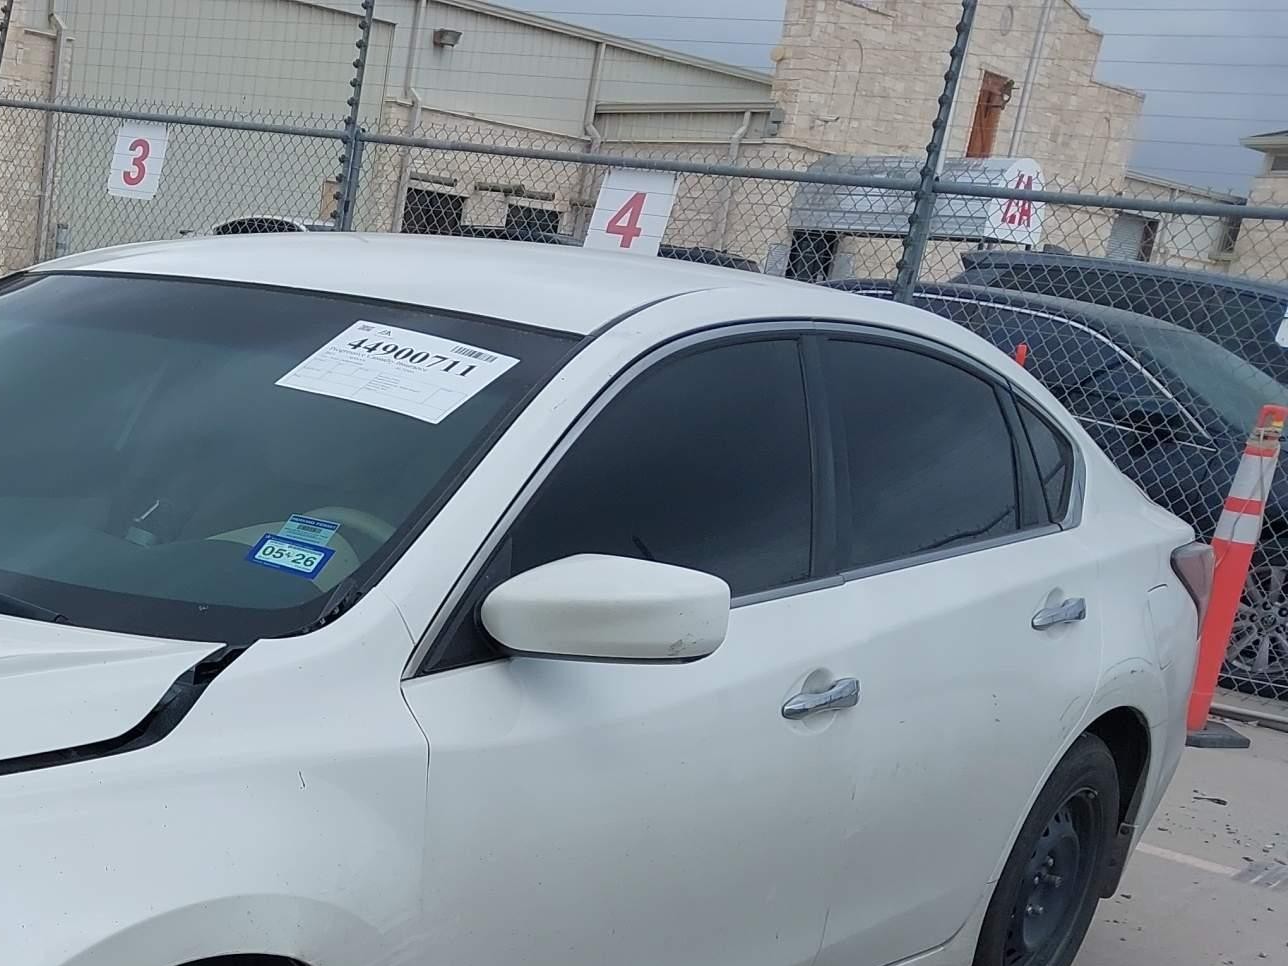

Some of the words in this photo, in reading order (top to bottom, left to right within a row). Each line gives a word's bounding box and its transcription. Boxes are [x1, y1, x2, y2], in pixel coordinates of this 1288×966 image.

[123, 138, 150, 186] 3
[605, 192, 648, 249] 4
[347, 338, 477, 377] 44900711
[261, 545, 287, 560] 05
[291, 553, 316, 567] 26
